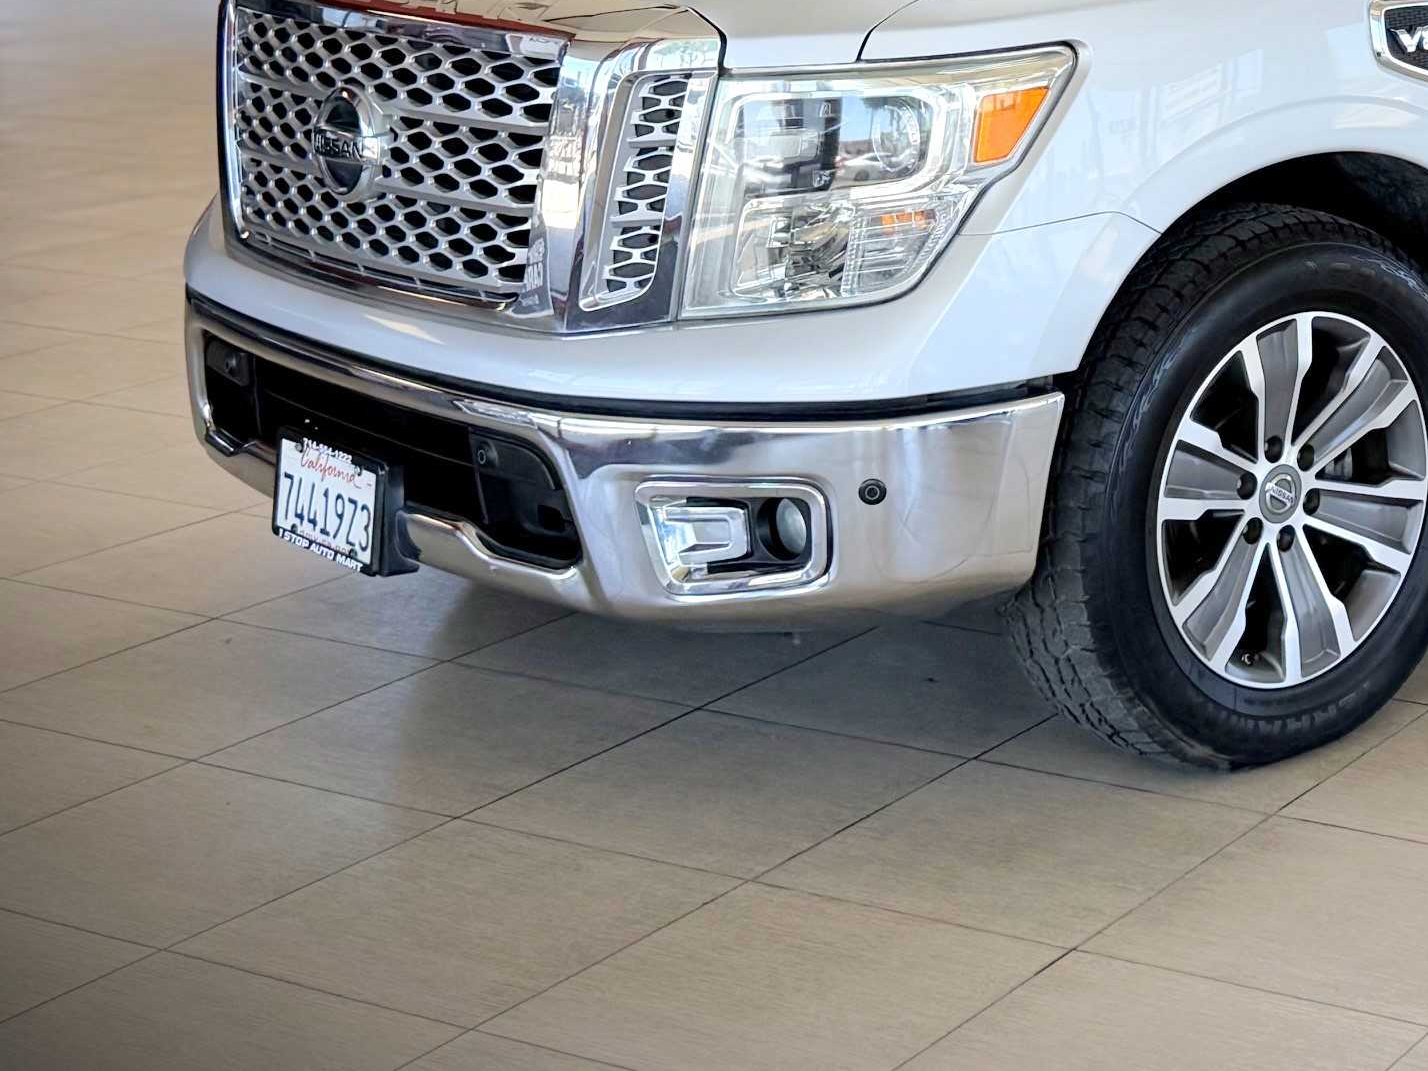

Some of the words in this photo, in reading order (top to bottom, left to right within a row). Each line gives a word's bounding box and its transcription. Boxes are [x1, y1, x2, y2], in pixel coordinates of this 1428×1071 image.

[284, 531, 310, 548] STOP
[309, 542, 335, 561] AUTO
[336, 554, 364, 572] MART
